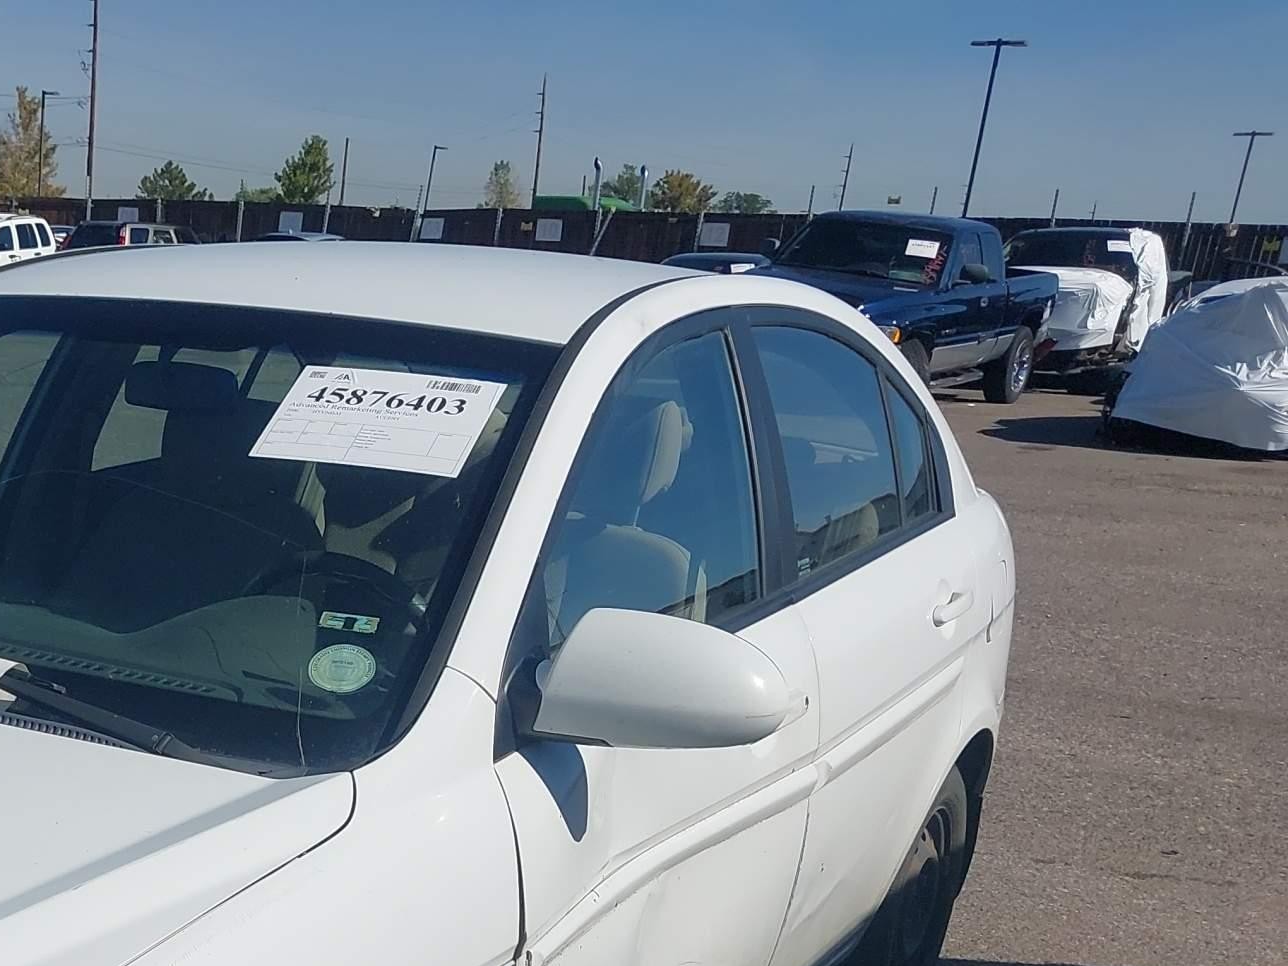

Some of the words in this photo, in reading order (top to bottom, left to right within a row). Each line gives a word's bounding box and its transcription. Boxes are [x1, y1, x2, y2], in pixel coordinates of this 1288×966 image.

[289, 401, 330, 409] Advanced
[330, 404, 383, 415] Remarketing
[384, 408, 419, 417] Services
[306, 385, 468, 416] 45876403
